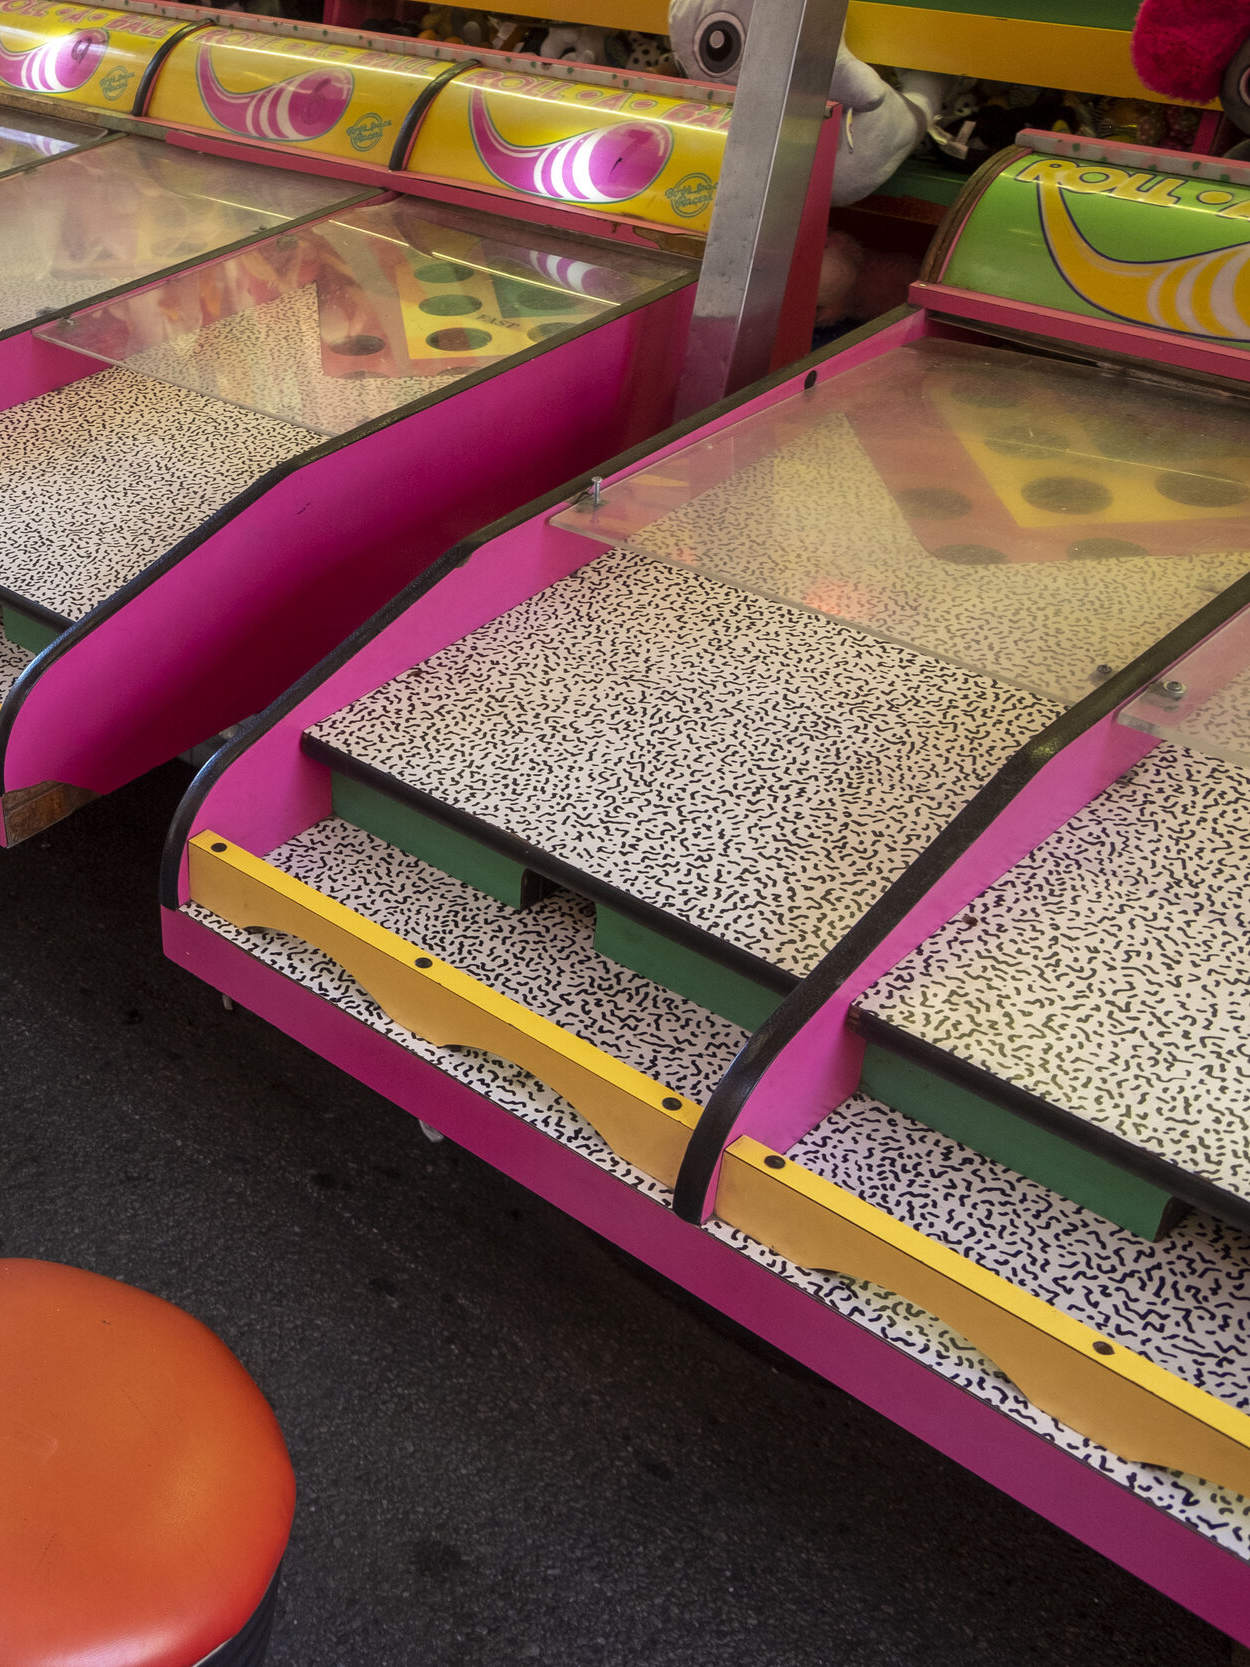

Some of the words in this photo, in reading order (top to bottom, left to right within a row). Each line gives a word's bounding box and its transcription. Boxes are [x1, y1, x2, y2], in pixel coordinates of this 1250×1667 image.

[104, 14, 180, 39] BALL
[193, 28, 286, 49] ROLL
[463, 69, 574, 101] ROLL
[658, 103, 732, 133] BA
[1015, 159, 1188, 207] ROLL
